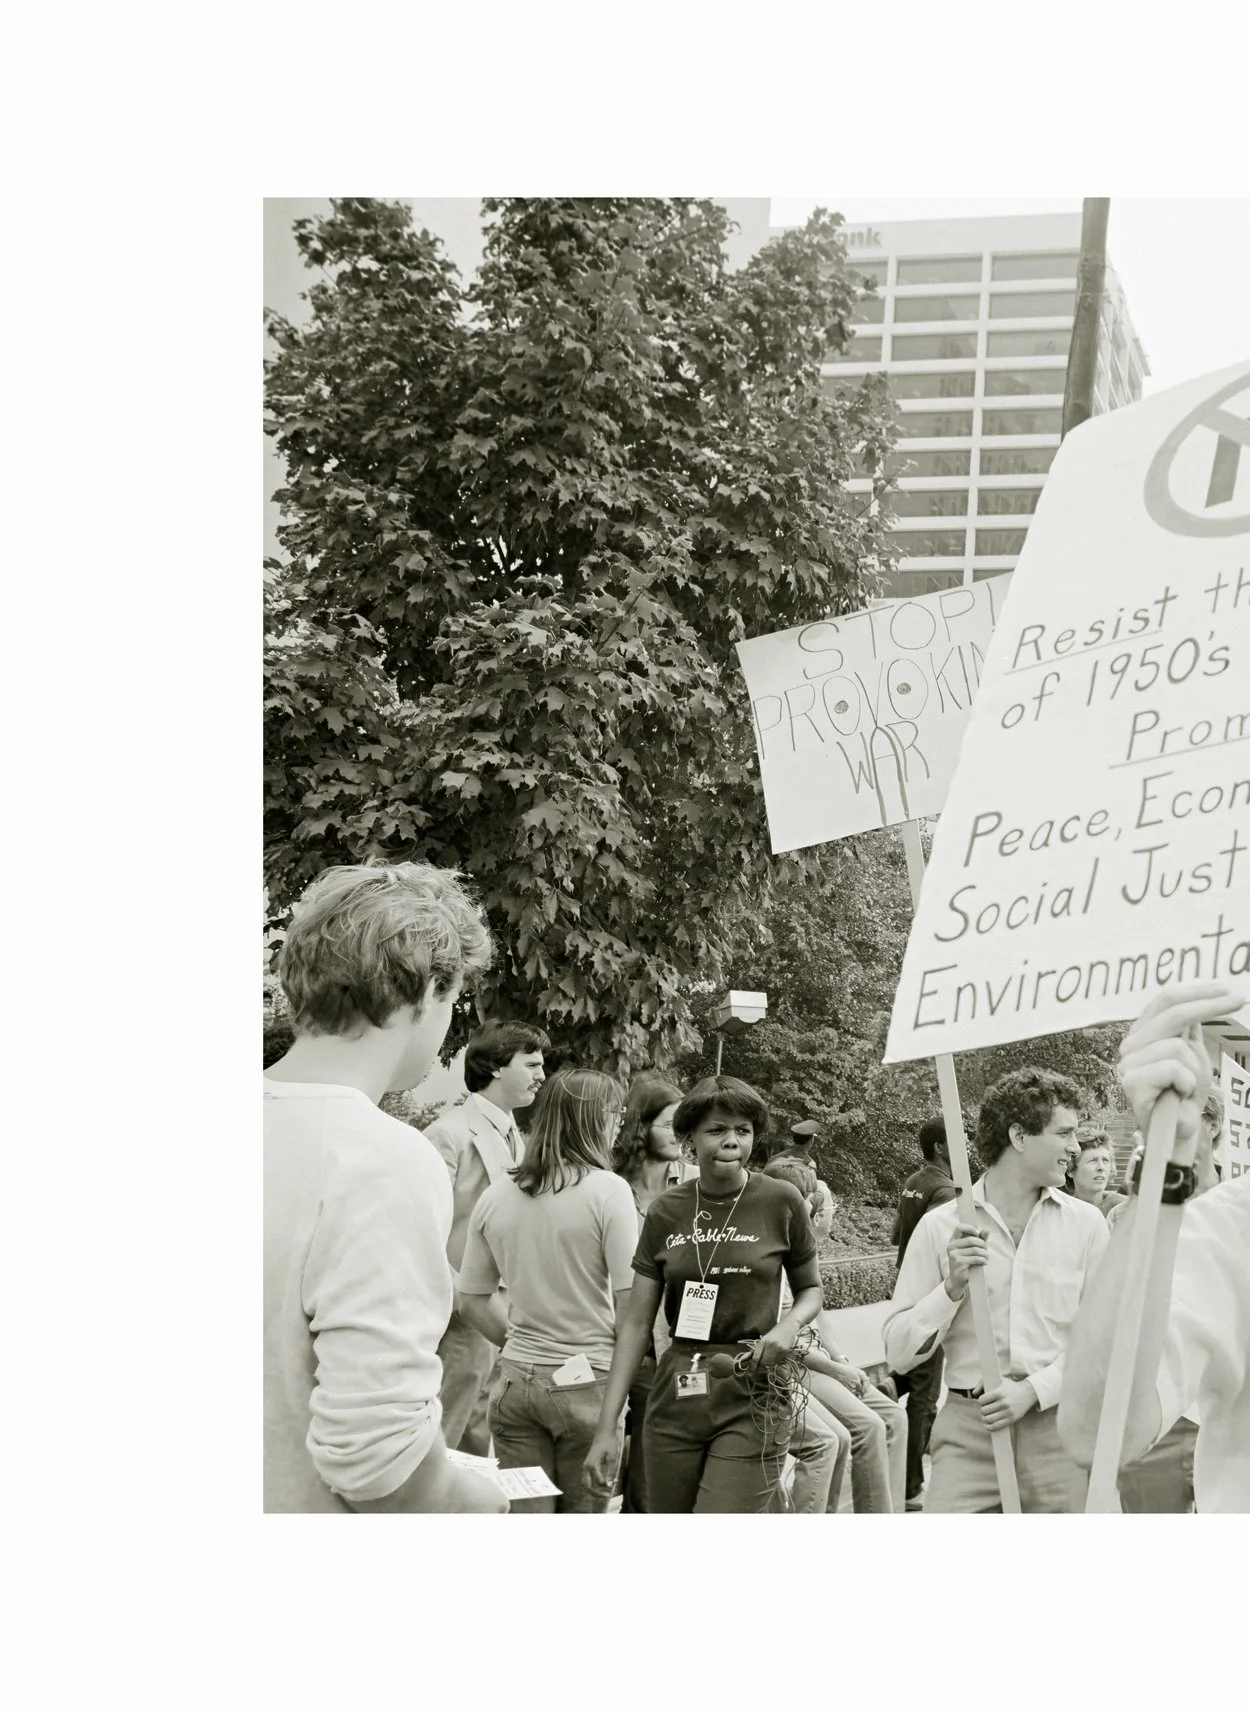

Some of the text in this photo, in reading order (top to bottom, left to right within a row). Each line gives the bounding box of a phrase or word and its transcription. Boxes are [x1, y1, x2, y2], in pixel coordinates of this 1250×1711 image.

[1012, 586, 1178, 669] Resist
[1001, 672, 1060, 729] of
[1087, 631, 1230, 706] 1950's
[836, 720, 930, 827] WAR
[964, 809, 1122, 867] Peace,
[934, 857, 1099, 942] Social
[686, 1287, 716, 1301] PRESS
